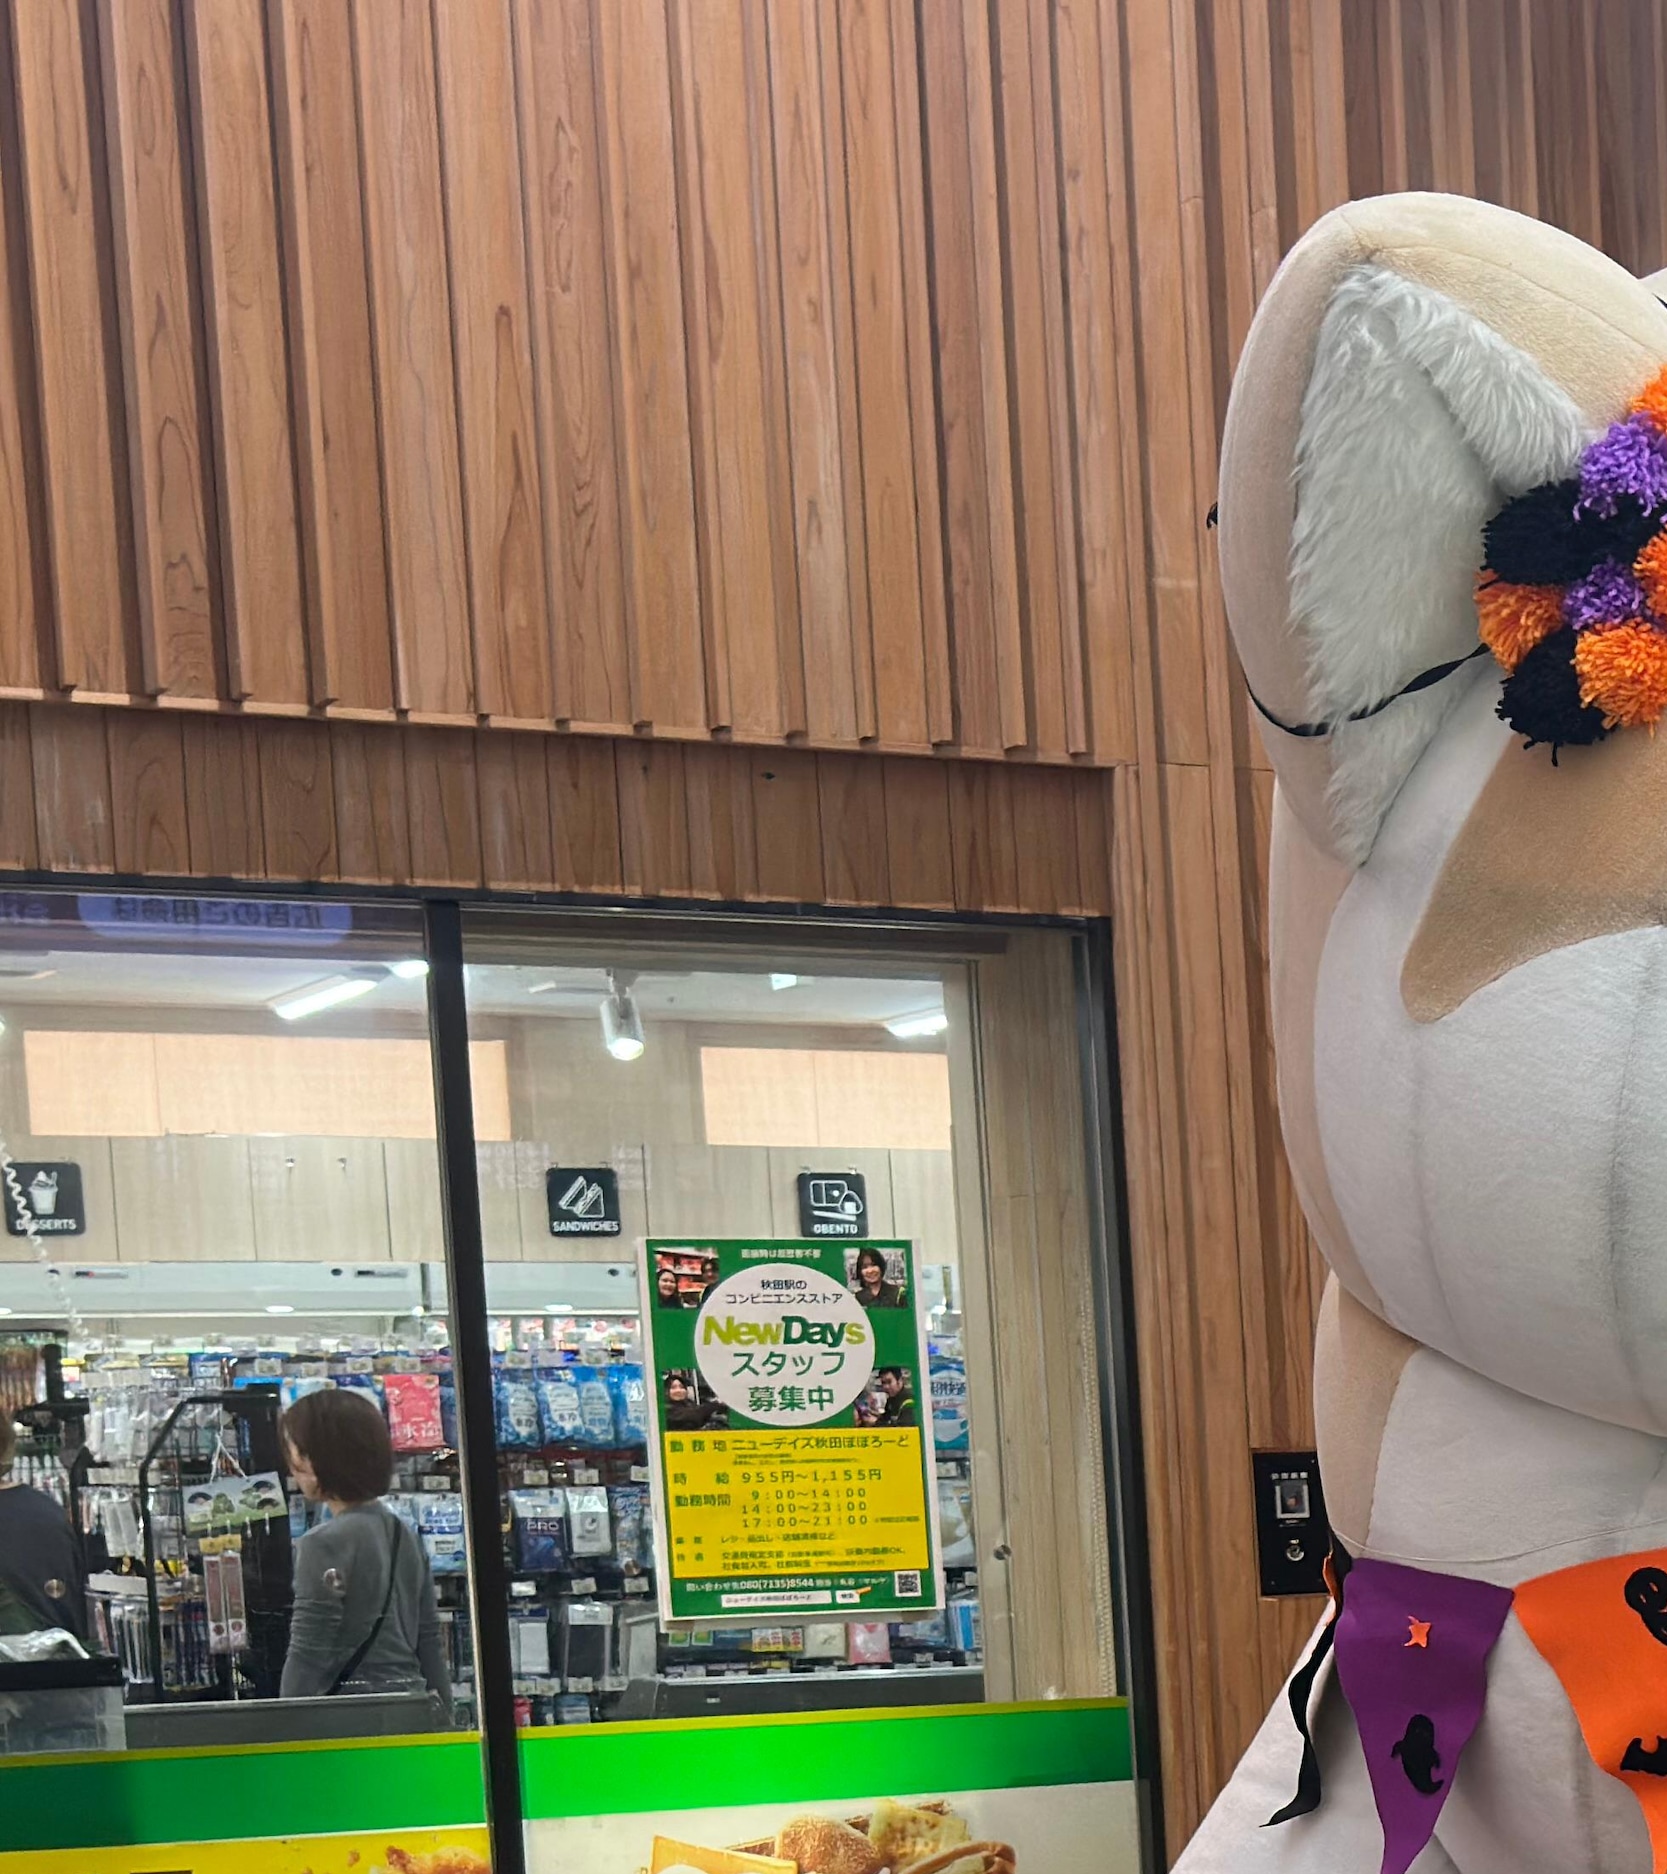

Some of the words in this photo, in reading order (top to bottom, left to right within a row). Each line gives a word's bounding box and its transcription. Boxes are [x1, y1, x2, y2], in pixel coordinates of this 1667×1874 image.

[552, 1220, 619, 1232] SANDWICHES
[813, 1223, 858, 1235] OBENTO
[725, 1292, 843, 1305] コンビニエンスストア
[703, 1315, 866, 1348] NewDays
[731, 1351, 845, 1377] スタッフ
[748, 1385, 835, 1412] 募集中
